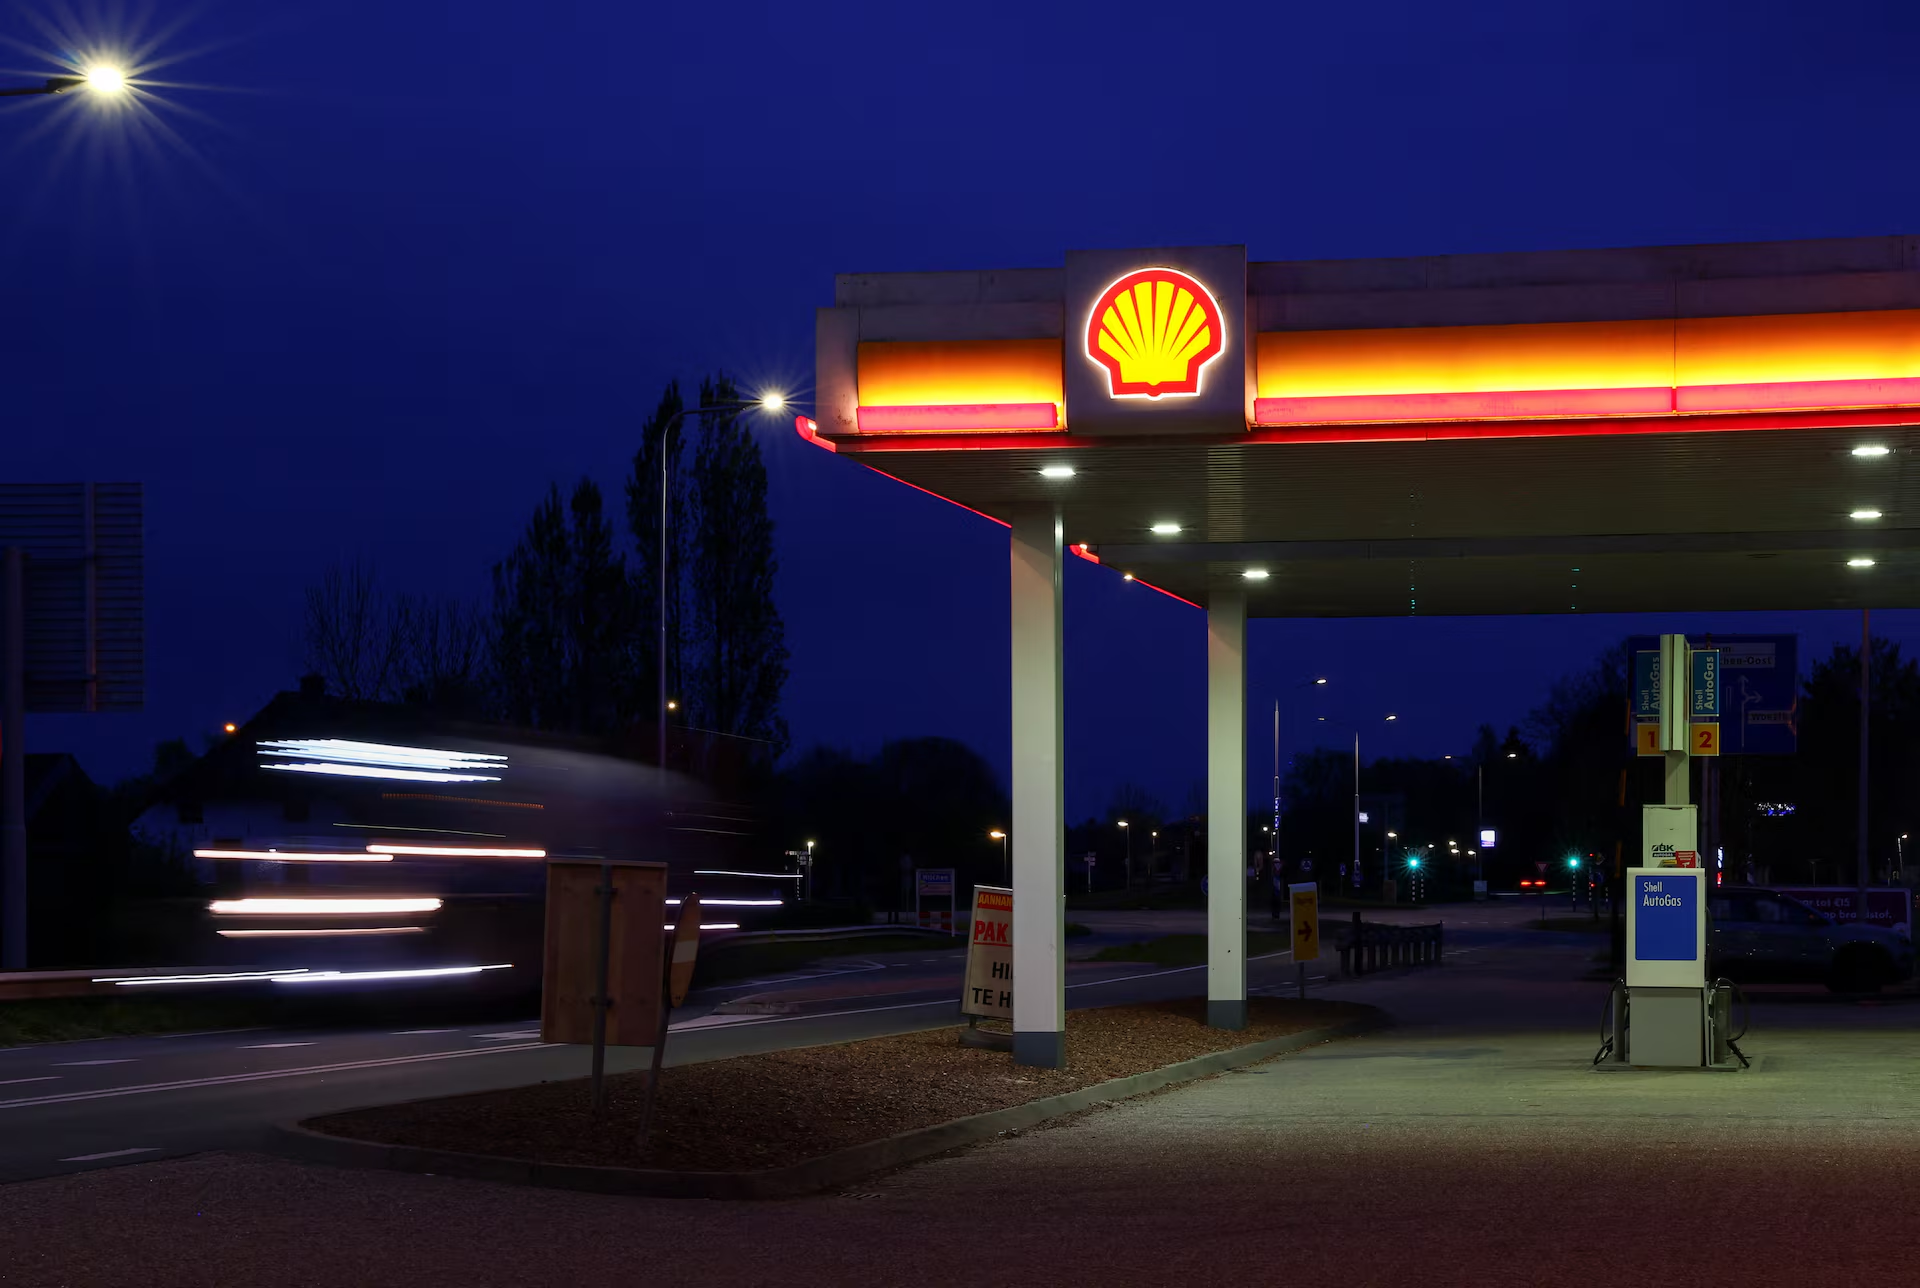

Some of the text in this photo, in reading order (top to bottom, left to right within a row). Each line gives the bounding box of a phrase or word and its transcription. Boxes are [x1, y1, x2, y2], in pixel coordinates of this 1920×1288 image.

[1650, 656, 1661, 710] AutoGas
[1703, 656, 1714, 710] AutoGas
[1641, 689, 1649, 711] Shell
[1695, 689, 1703, 710] Shell
[1648, 731, 1655, 748] 1
[1699, 731, 1712, 748] 2
[1643, 881, 1664, 893] Shell
[1642, 894, 1682, 907] AutoGas
[1839, 909, 1892, 919] brastof.
[974, 920, 1009, 942] PAK
[992, 962, 1013, 980] HI
[972, 987, 1013, 1008] TE H
